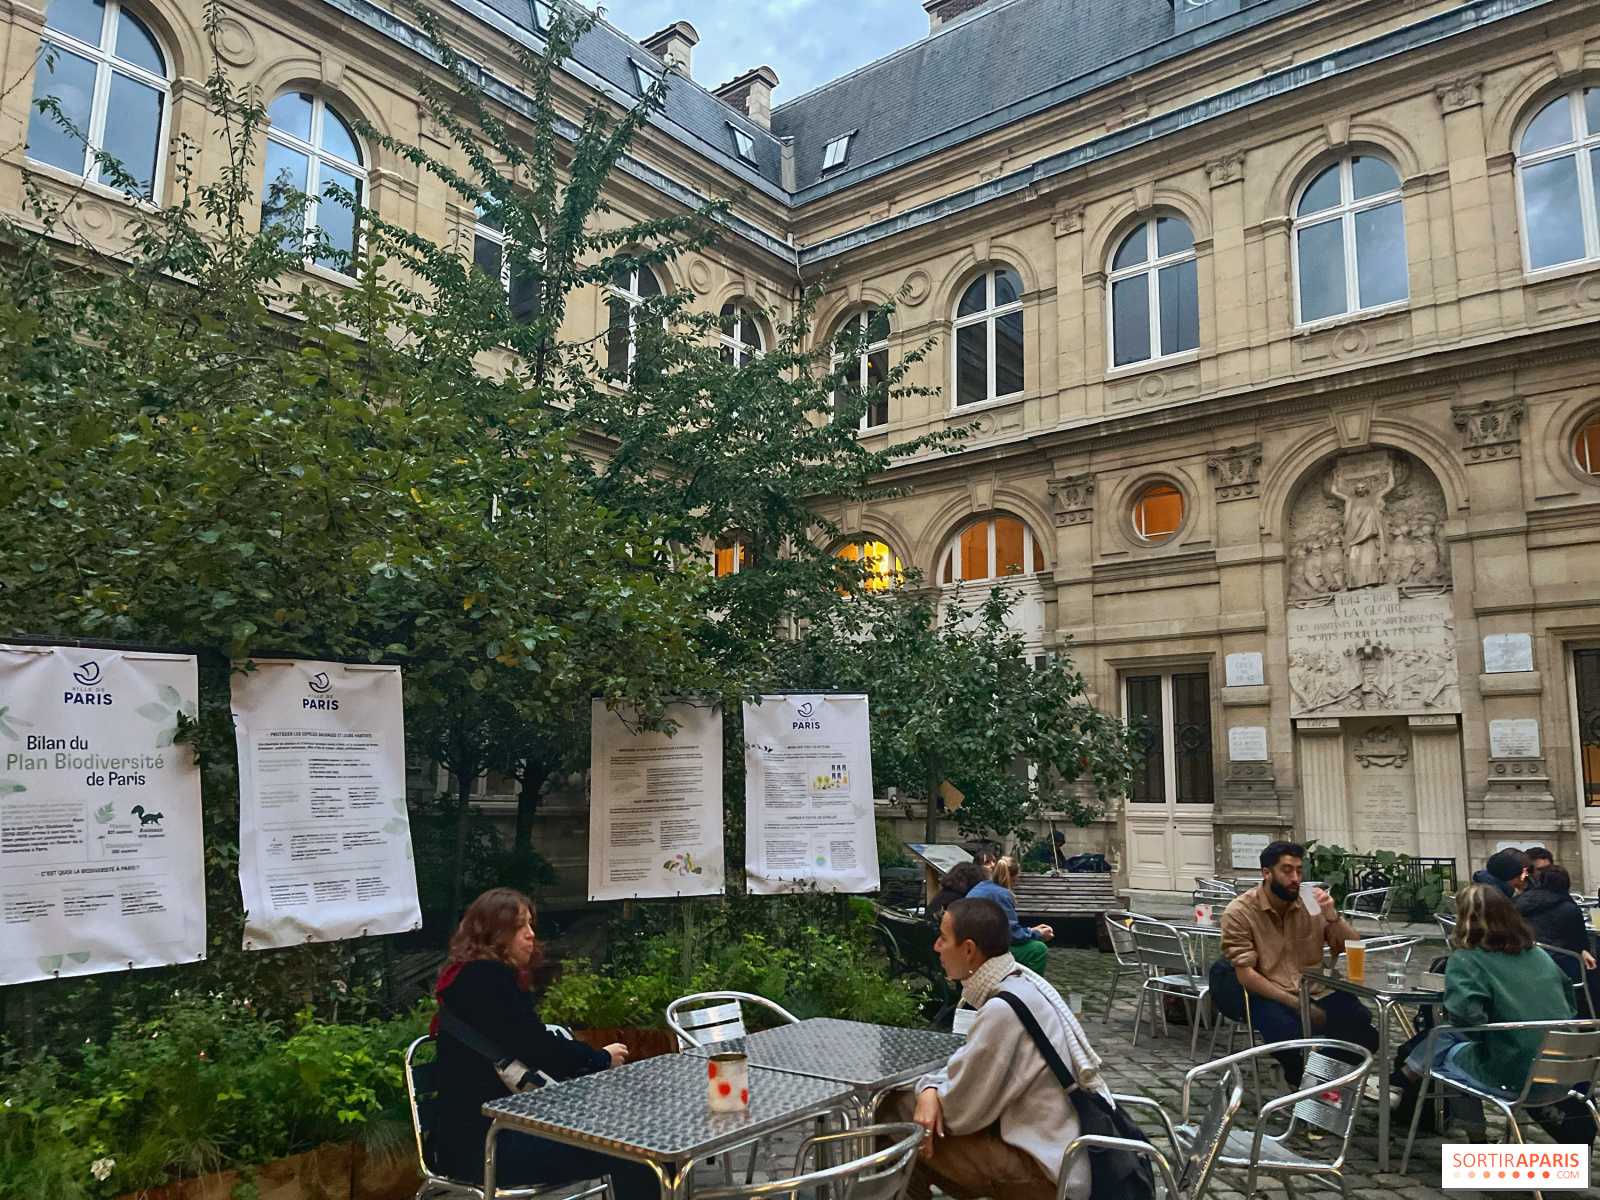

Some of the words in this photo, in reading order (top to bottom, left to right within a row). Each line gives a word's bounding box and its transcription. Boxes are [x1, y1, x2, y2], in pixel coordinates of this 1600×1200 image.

[1344, 607, 1359, 618] LA
[1364, 603, 1405, 616] GLOIRE
[1296, 623, 1310, 633] DES
[1355, 619, 1366, 628] DU
[1308, 632, 1339, 643] MORTS
[1344, 629, 1371, 640] POUR
[1375, 628, 1389, 638] LA
[1393, 625, 1434, 637] FRANCE
[64, 691, 113, 706] PARIS
[302, 698, 339, 711] PARIS
[792, 721, 820, 730] PARIS
[27, 735, 66, 751] Bilan
[70, 735, 89, 751] du
[6, 753, 48, 771] Plan
[55, 752, 164, 771] Biodiversité
[86, 772, 105, 787] de
[108, 771, 146, 787] Paris
